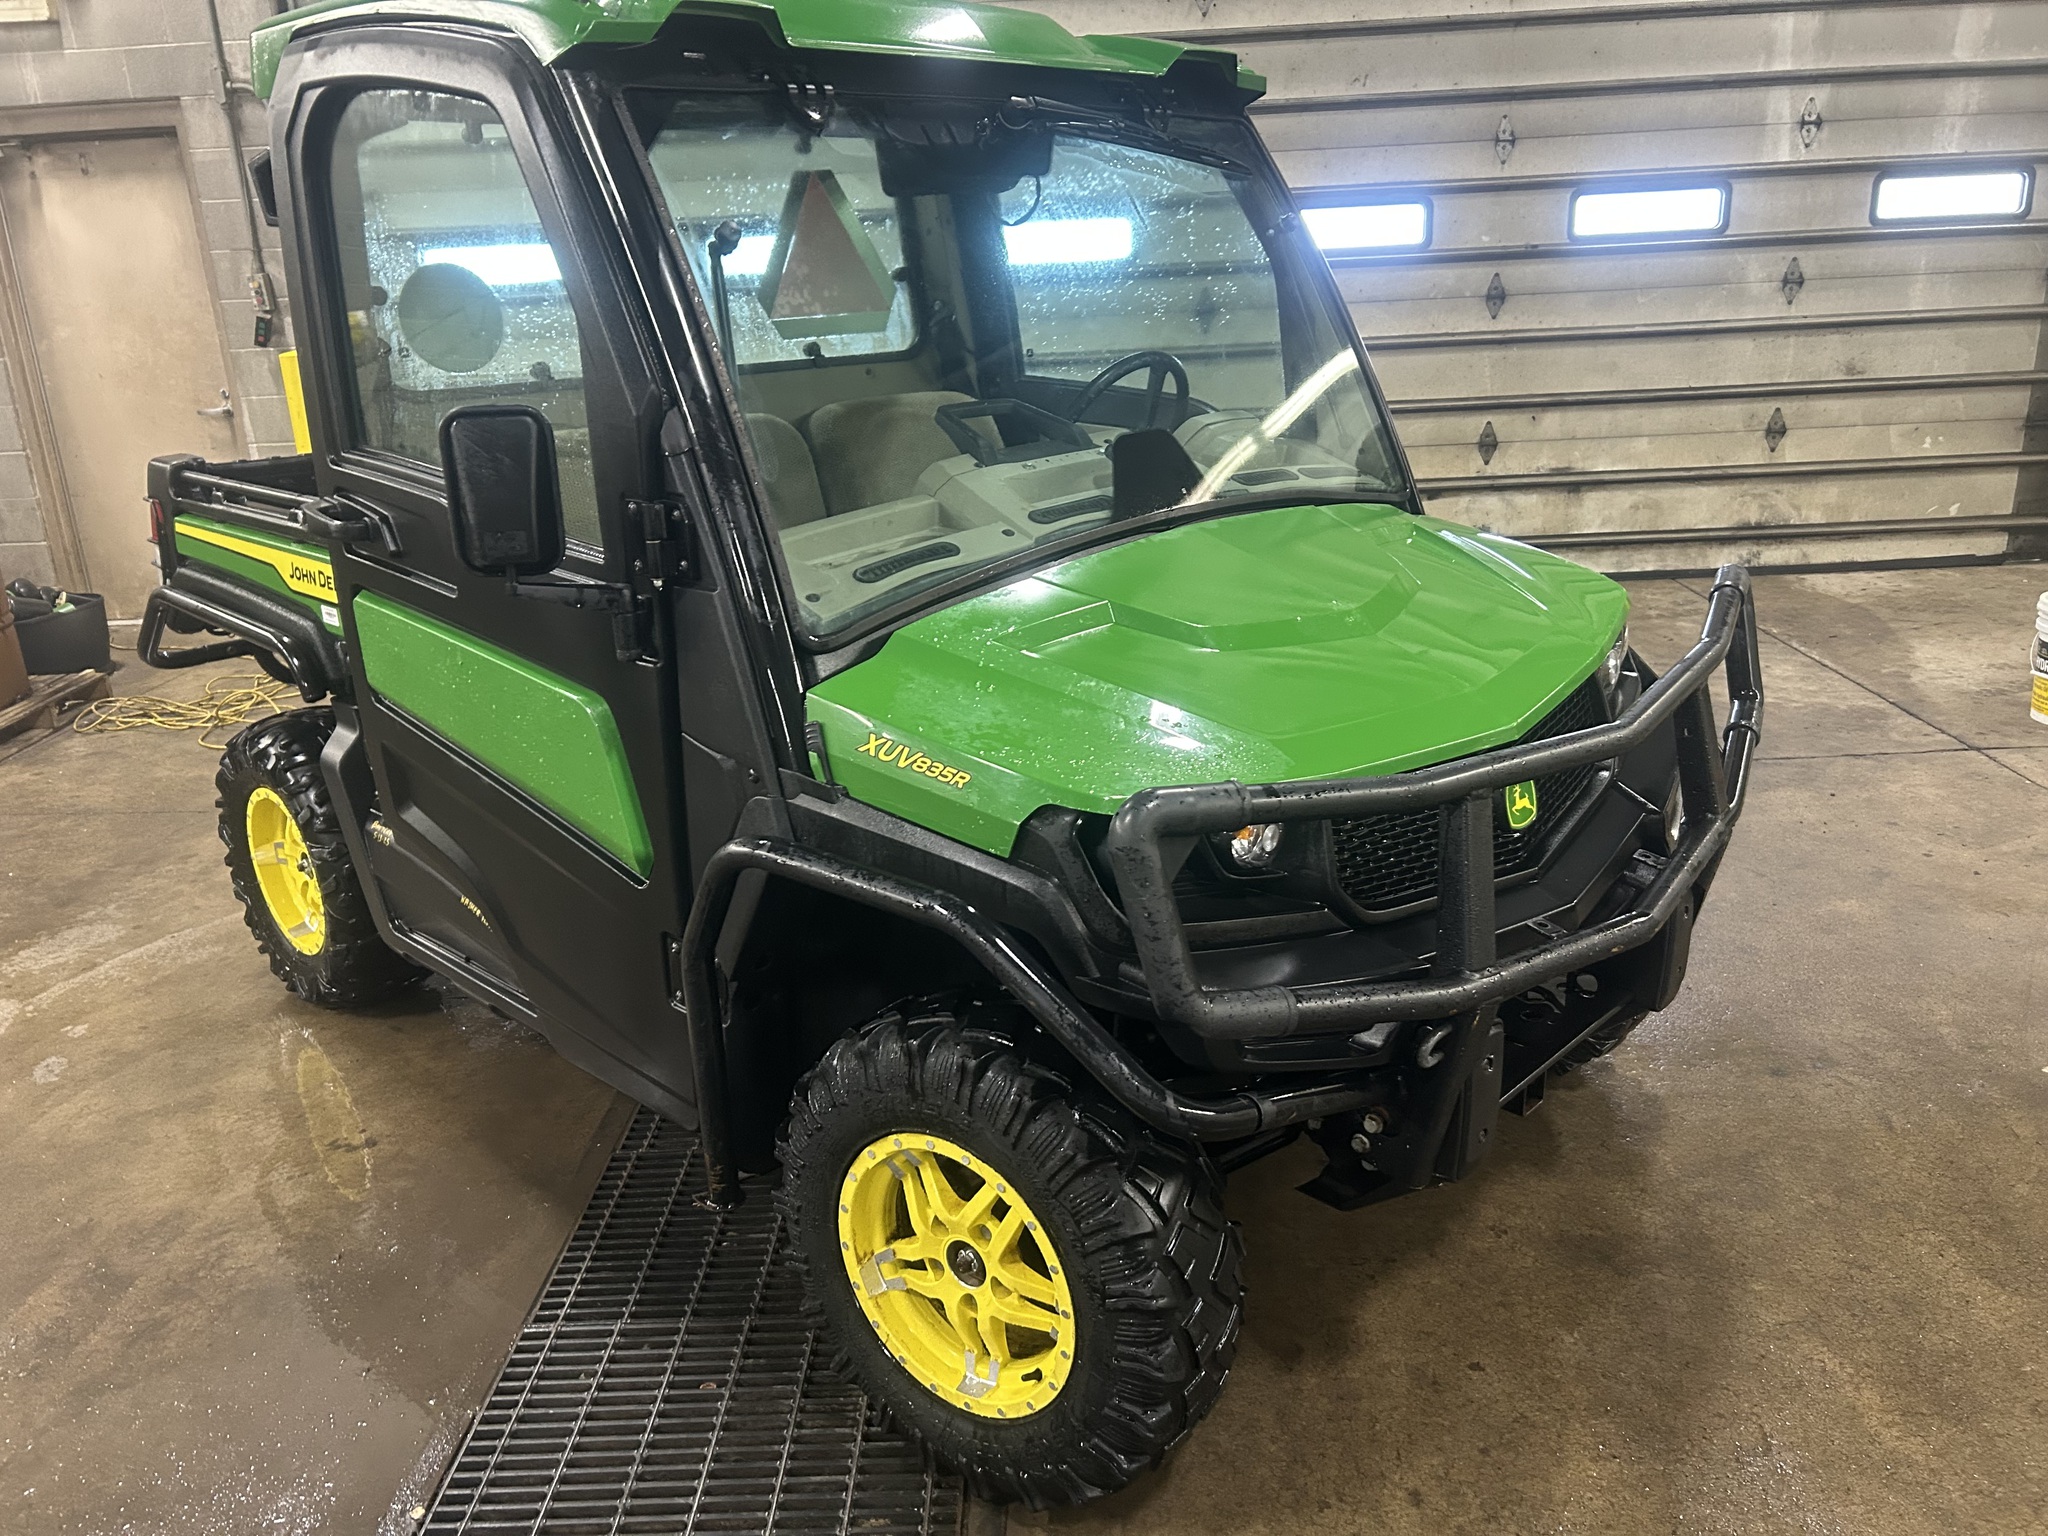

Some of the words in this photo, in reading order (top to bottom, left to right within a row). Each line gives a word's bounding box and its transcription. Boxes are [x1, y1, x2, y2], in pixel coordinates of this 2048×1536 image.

[289, 562, 317, 586] JOHN
[318, 570, 337, 591] DE
[855, 732, 972, 790] XUV835R
